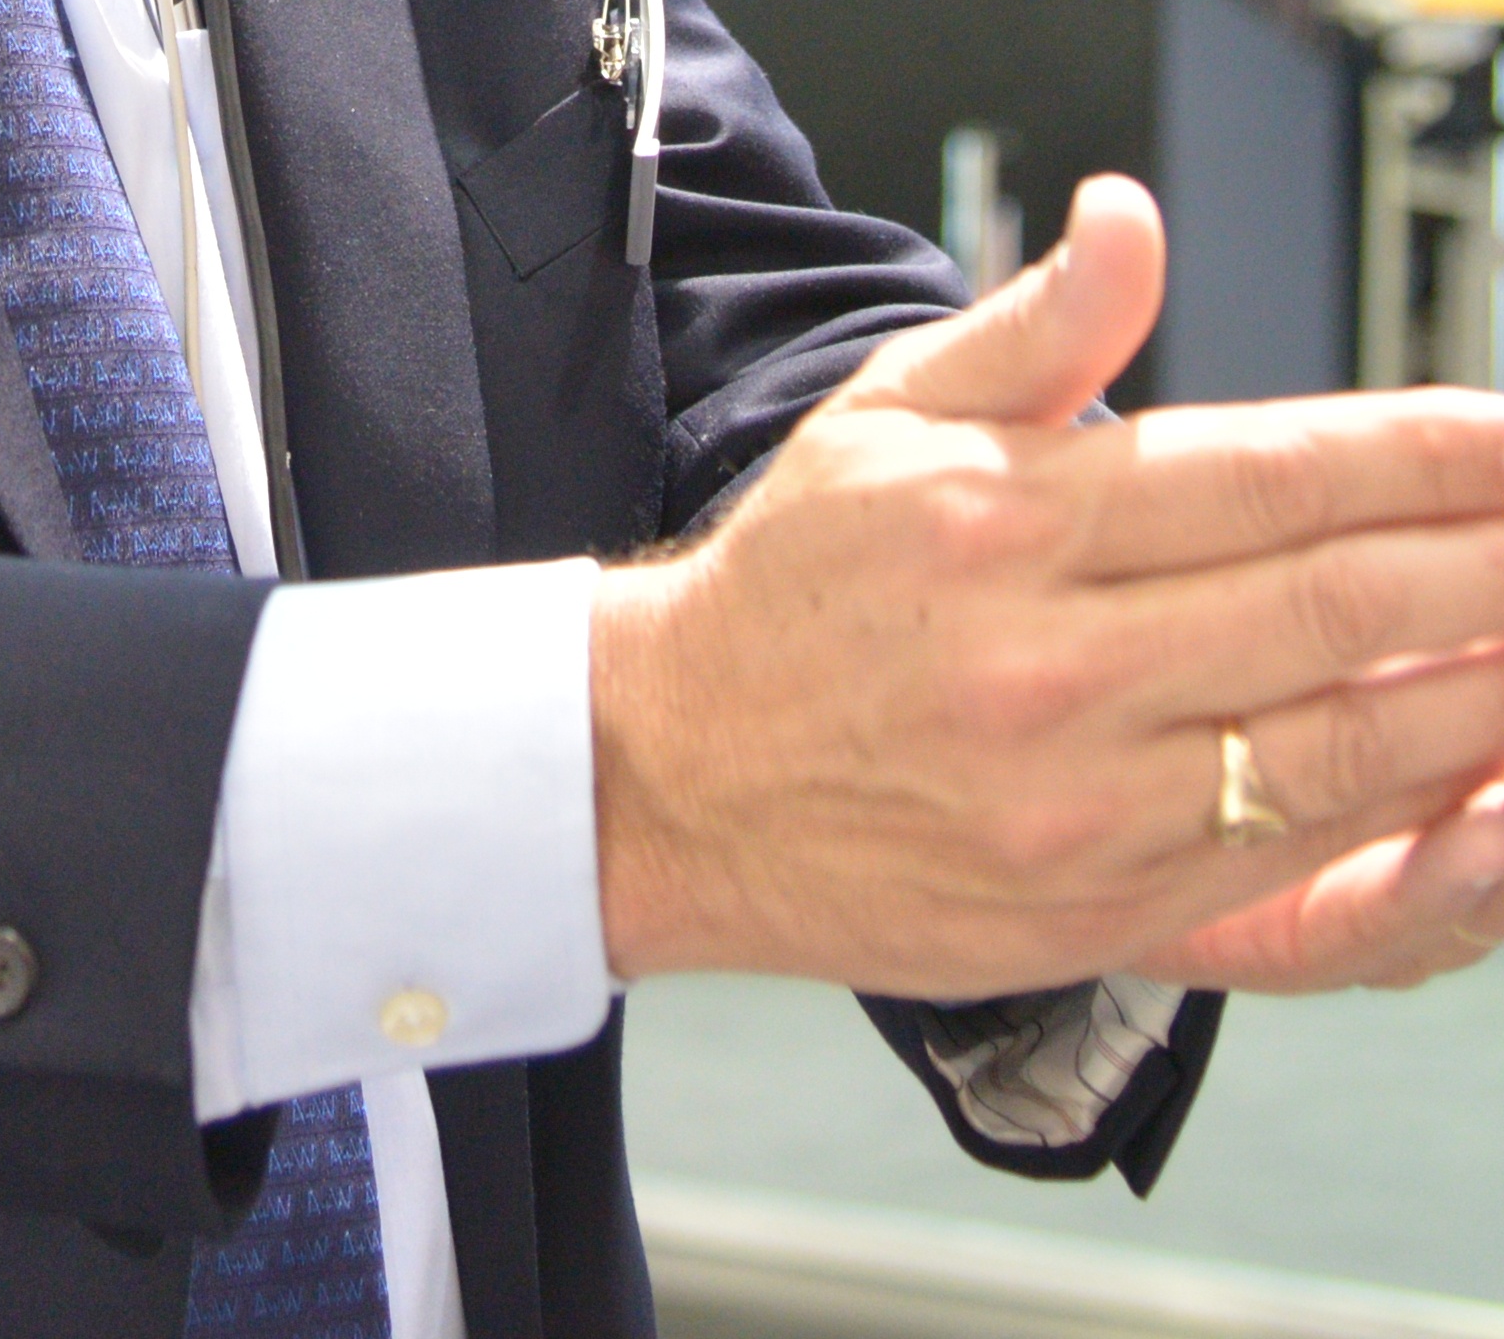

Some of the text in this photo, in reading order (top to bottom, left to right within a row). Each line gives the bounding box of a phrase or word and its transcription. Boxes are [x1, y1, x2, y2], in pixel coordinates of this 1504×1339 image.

[72, 402, 122, 433] A+W
[91, 487, 141, 517] A+W
[292, 1094, 335, 1124] A+W
[268, 1142, 316, 1174] A+W
[307, 1185, 353, 1216] A+W
[217, 1245, 269, 1276] A+W
[282, 1236, 329, 1265] A+W
